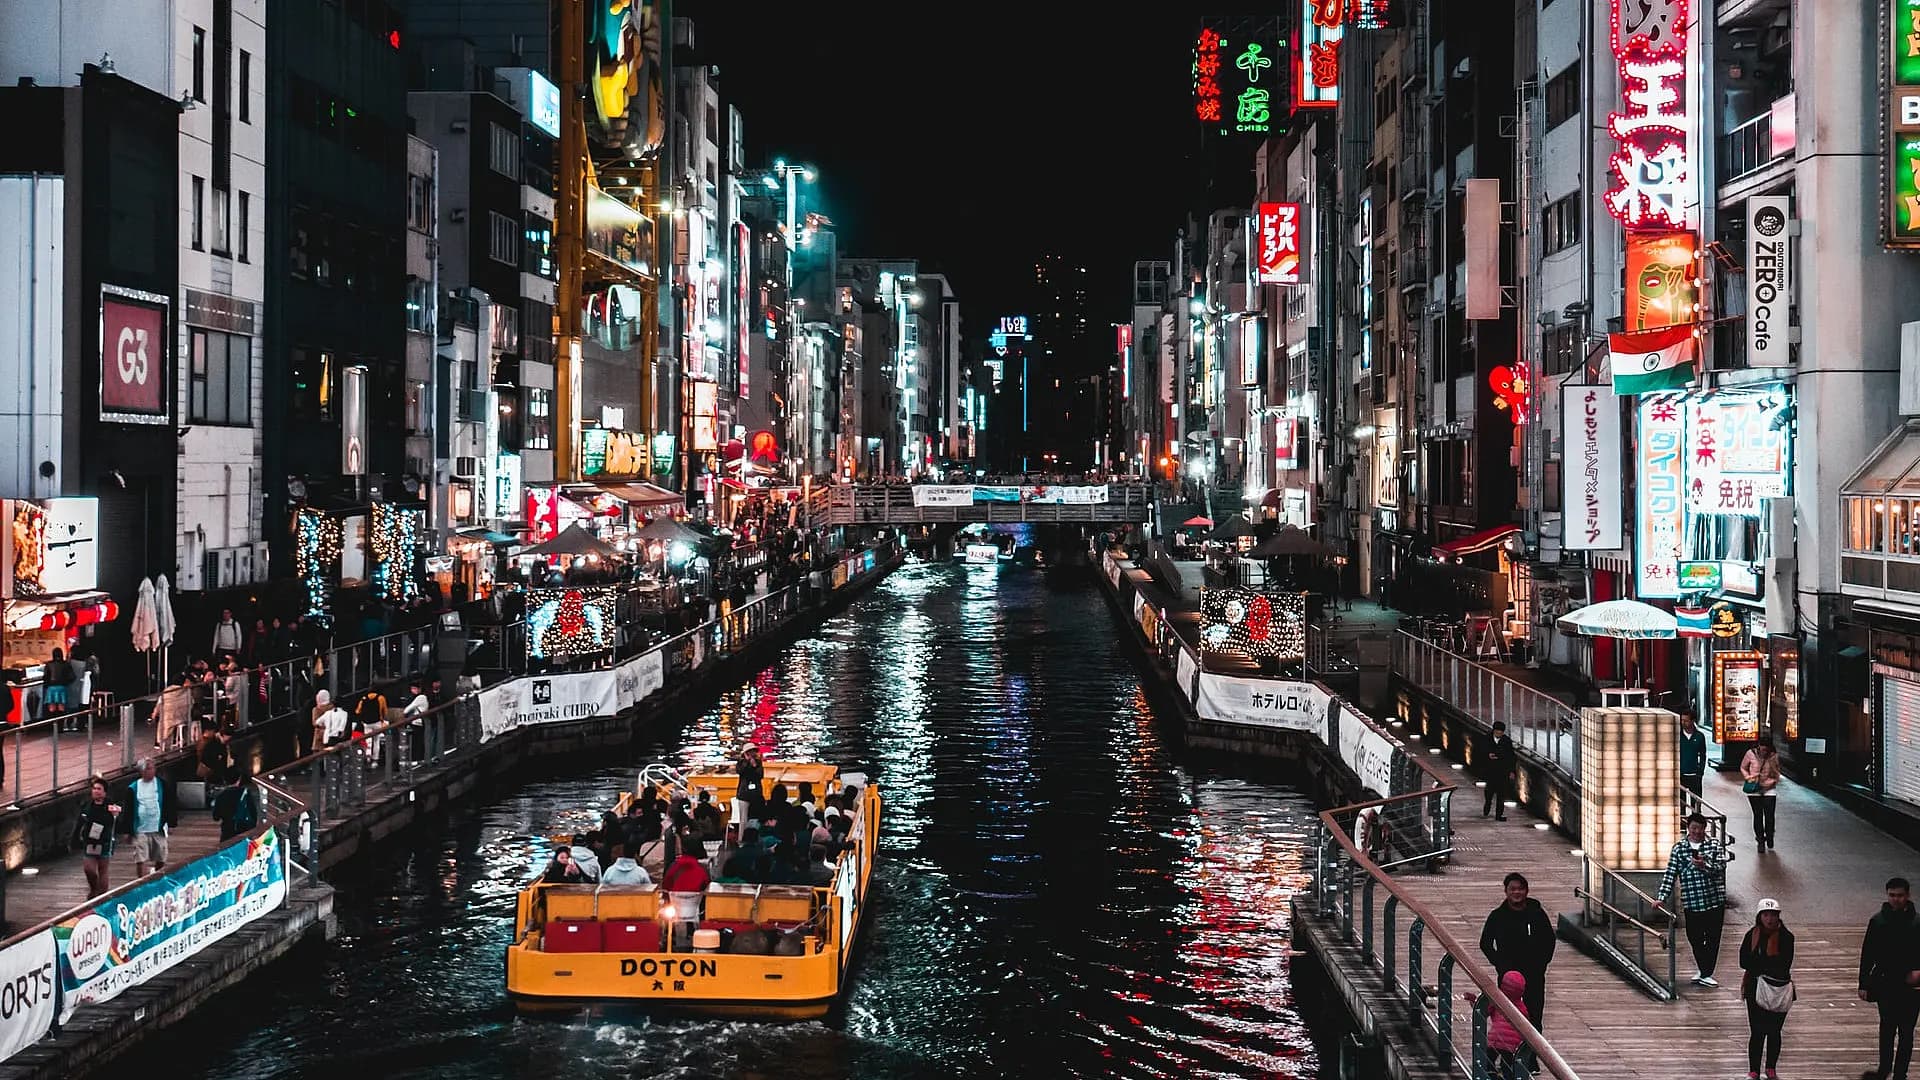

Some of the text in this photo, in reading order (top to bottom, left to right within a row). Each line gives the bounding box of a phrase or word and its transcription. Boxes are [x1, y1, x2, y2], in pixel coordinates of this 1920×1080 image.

[1236, 43, 1271, 122] 千房
[1236, 124, 1269, 132] CHIBO
[1263, 214, 1279, 263] ドラッグ
[1278, 206, 1296, 252] ツルハ
[1755, 241, 1777, 304] ZERO
[117, 327, 148, 385] G3
[1584, 390, 1600, 544] よしもとエンタメショップ
[1650, 431, 1677, 514] ダイコク
[1718, 479, 1754, 509] 免税
[72, 923, 108, 958] WAON
[620, 958, 717, 977] DOTON
[652, 980, 686, 992] 大阪
